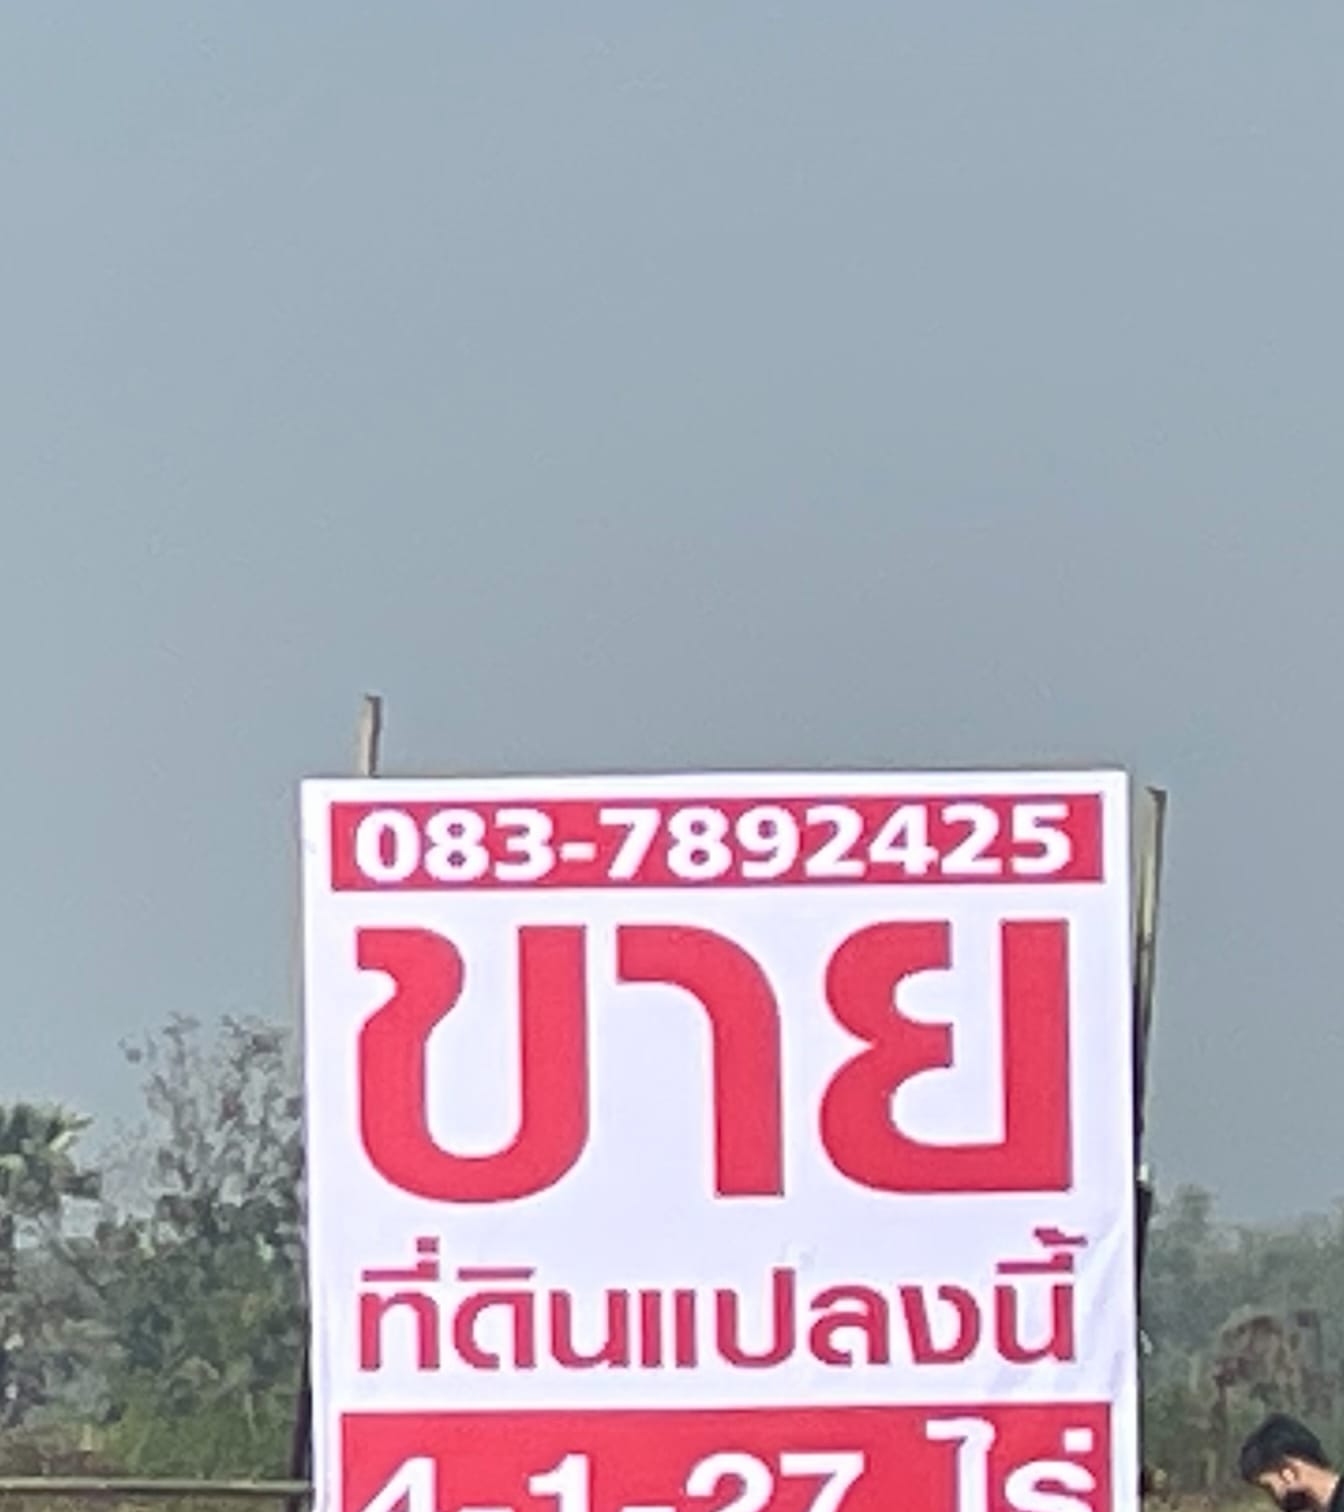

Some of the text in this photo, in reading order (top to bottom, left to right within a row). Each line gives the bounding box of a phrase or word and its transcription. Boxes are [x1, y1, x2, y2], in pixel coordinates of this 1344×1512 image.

[353, 803, 1073, 883] 083-7892425
[353, 917, 1073, 1205] ขาย
[357, 1226, 1089, 1372] ที่ดินแปลงนี้
